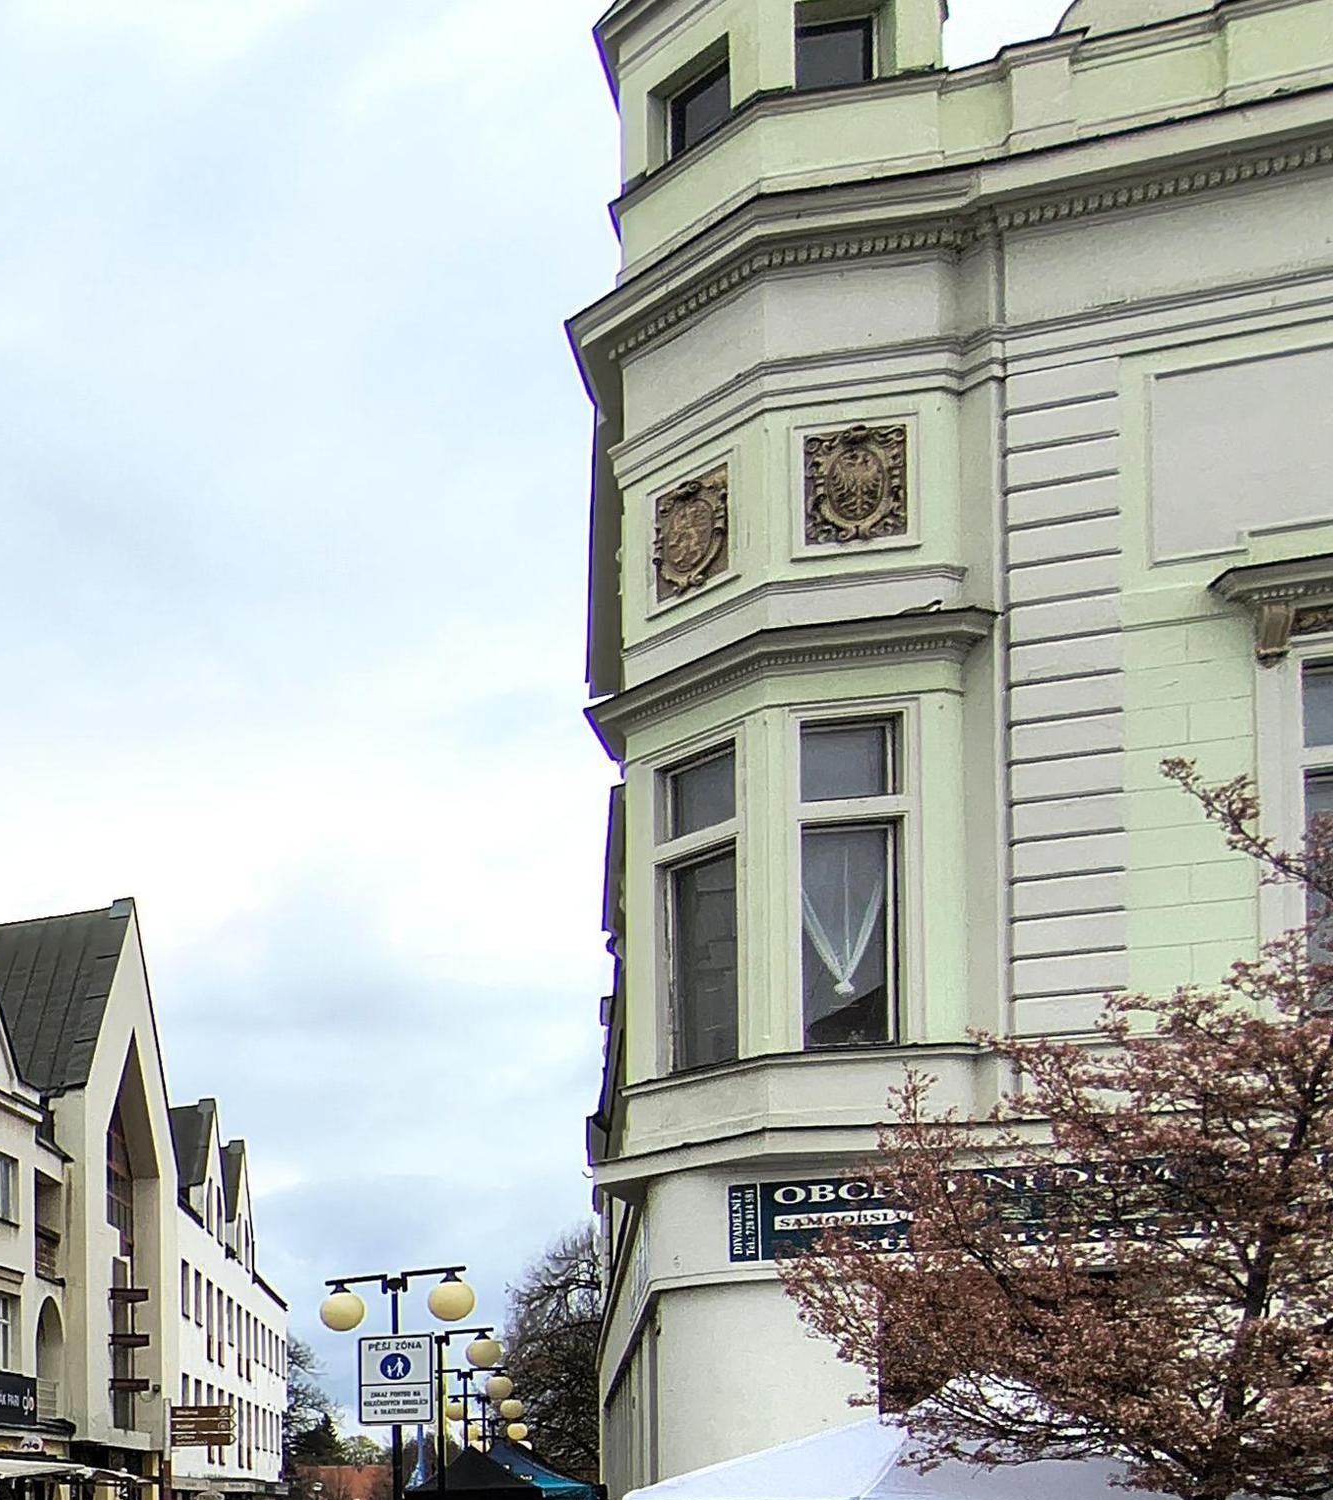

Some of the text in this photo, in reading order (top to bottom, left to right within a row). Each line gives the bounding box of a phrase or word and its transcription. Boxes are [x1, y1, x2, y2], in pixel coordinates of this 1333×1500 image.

[731, 1199, 743, 1255] DIVADELNÍ
[368, 1340, 422, 1351] PĚŠÍ ZÓNA
